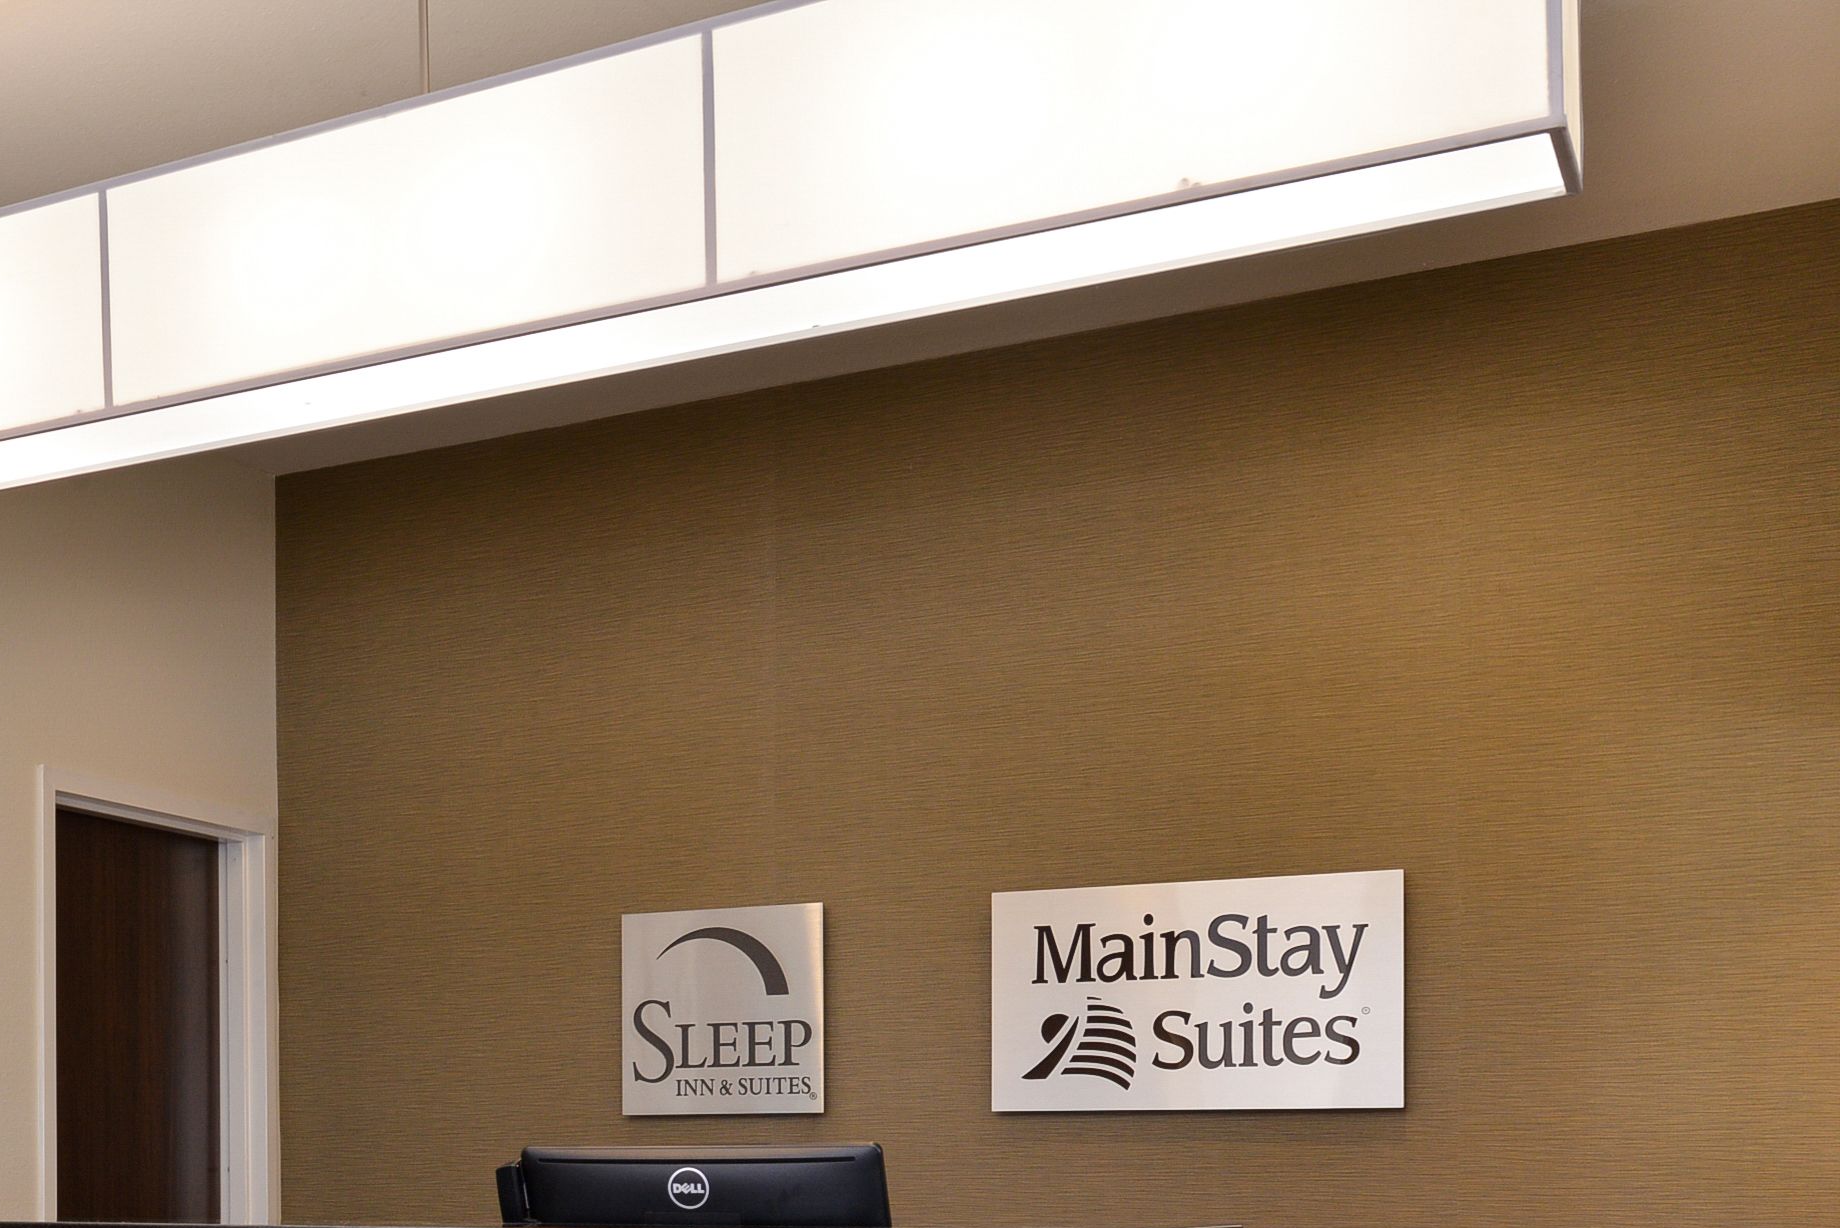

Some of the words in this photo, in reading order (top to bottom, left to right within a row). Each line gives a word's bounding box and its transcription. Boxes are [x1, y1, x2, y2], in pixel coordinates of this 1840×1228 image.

[1032, 913, 1369, 1000] MainStay
[632, 999, 812, 1083] SLEEP
[1151, 1002, 1360, 1070] Suites
[676, 1079, 715, 1097] INN
[720, 1080, 733, 1096] &
[673, 1183, 705, 1195] DELL
